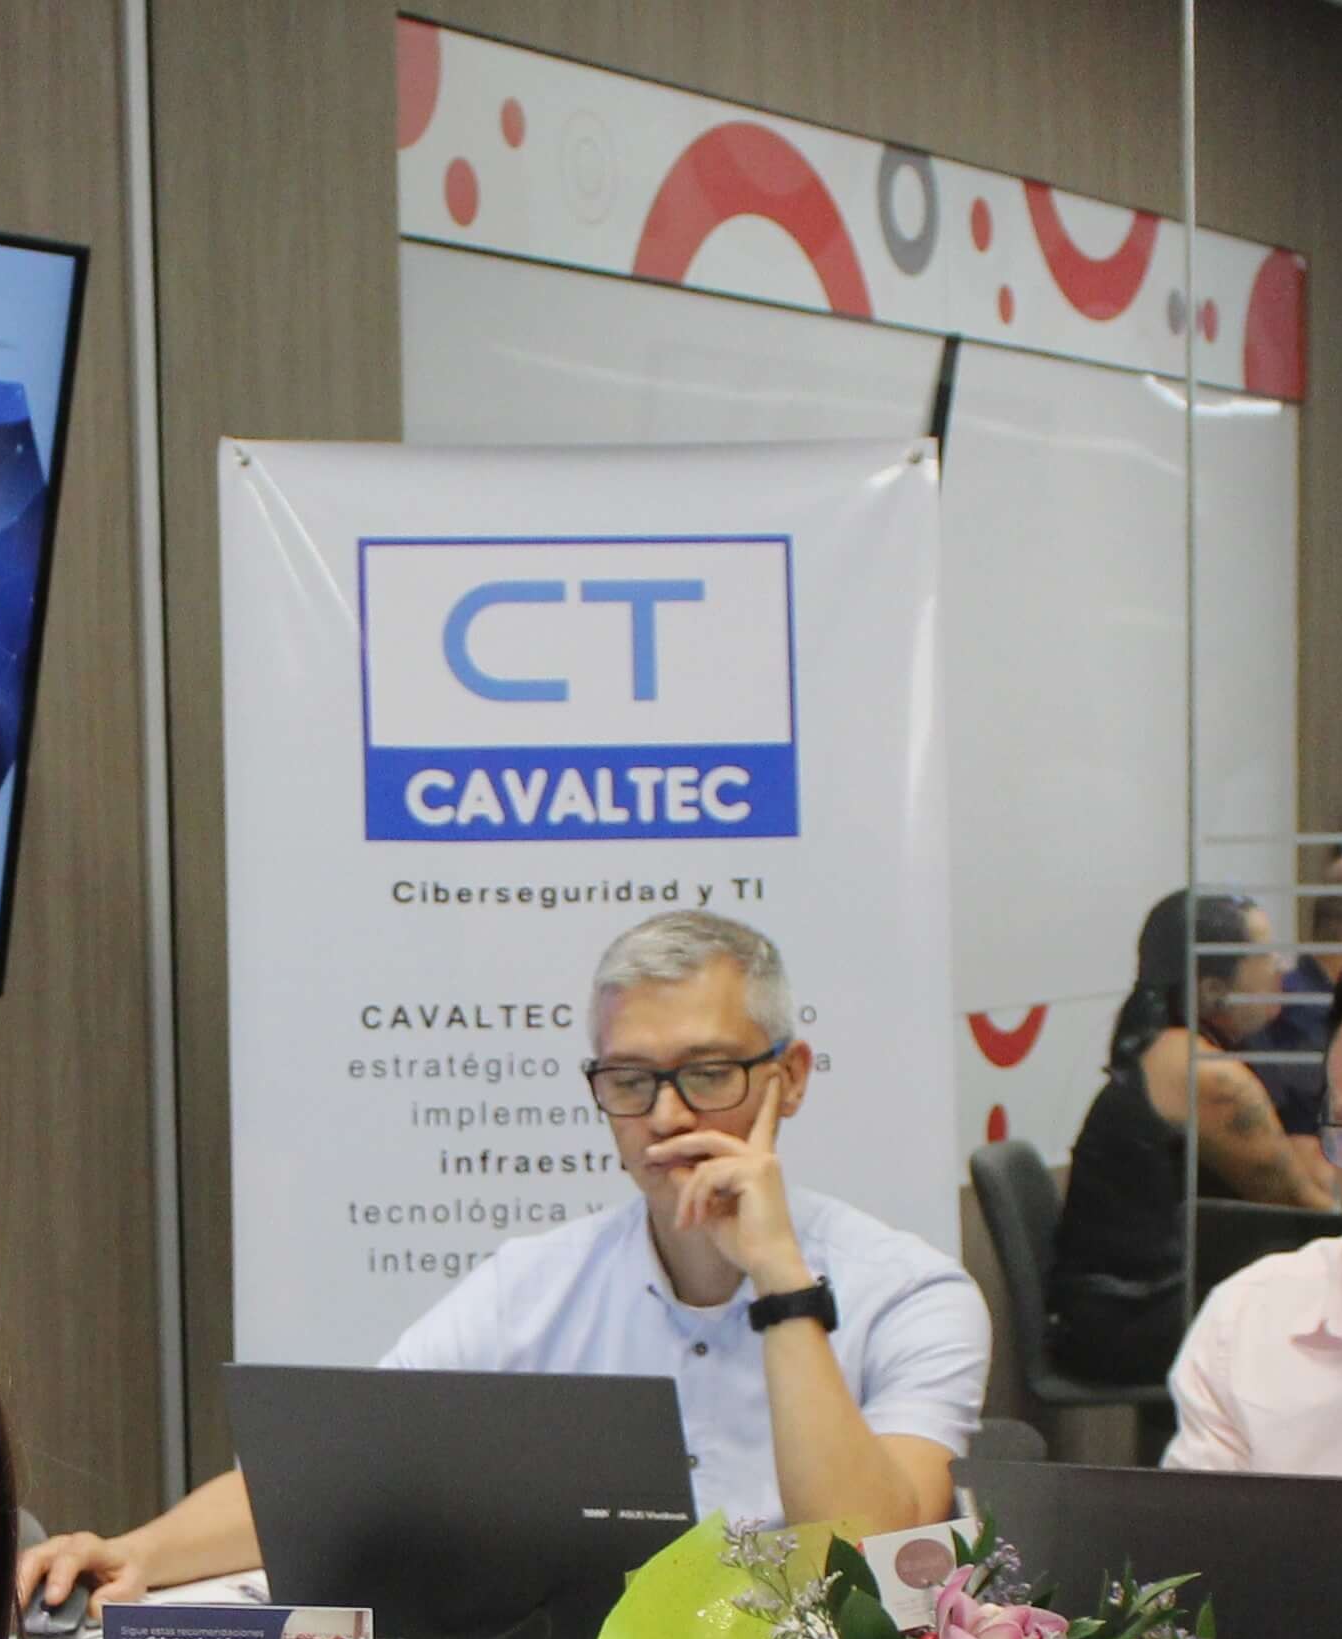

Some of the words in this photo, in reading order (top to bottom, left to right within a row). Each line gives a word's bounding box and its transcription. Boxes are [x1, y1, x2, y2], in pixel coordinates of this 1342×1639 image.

[441, 579, 705, 702] CT
[405, 765, 751, 827] CAVALTEC
[392, 879, 679, 908] Ciberseguridad
[697, 884, 714, 906] y
[730, 879, 765, 901] TI
[361, 1004, 574, 1030] CAVALTEC
[348, 1052, 561, 1083] estratégico
[348, 1198, 568, 1229] tecnológica
[369, 1249, 496, 1278] integr
